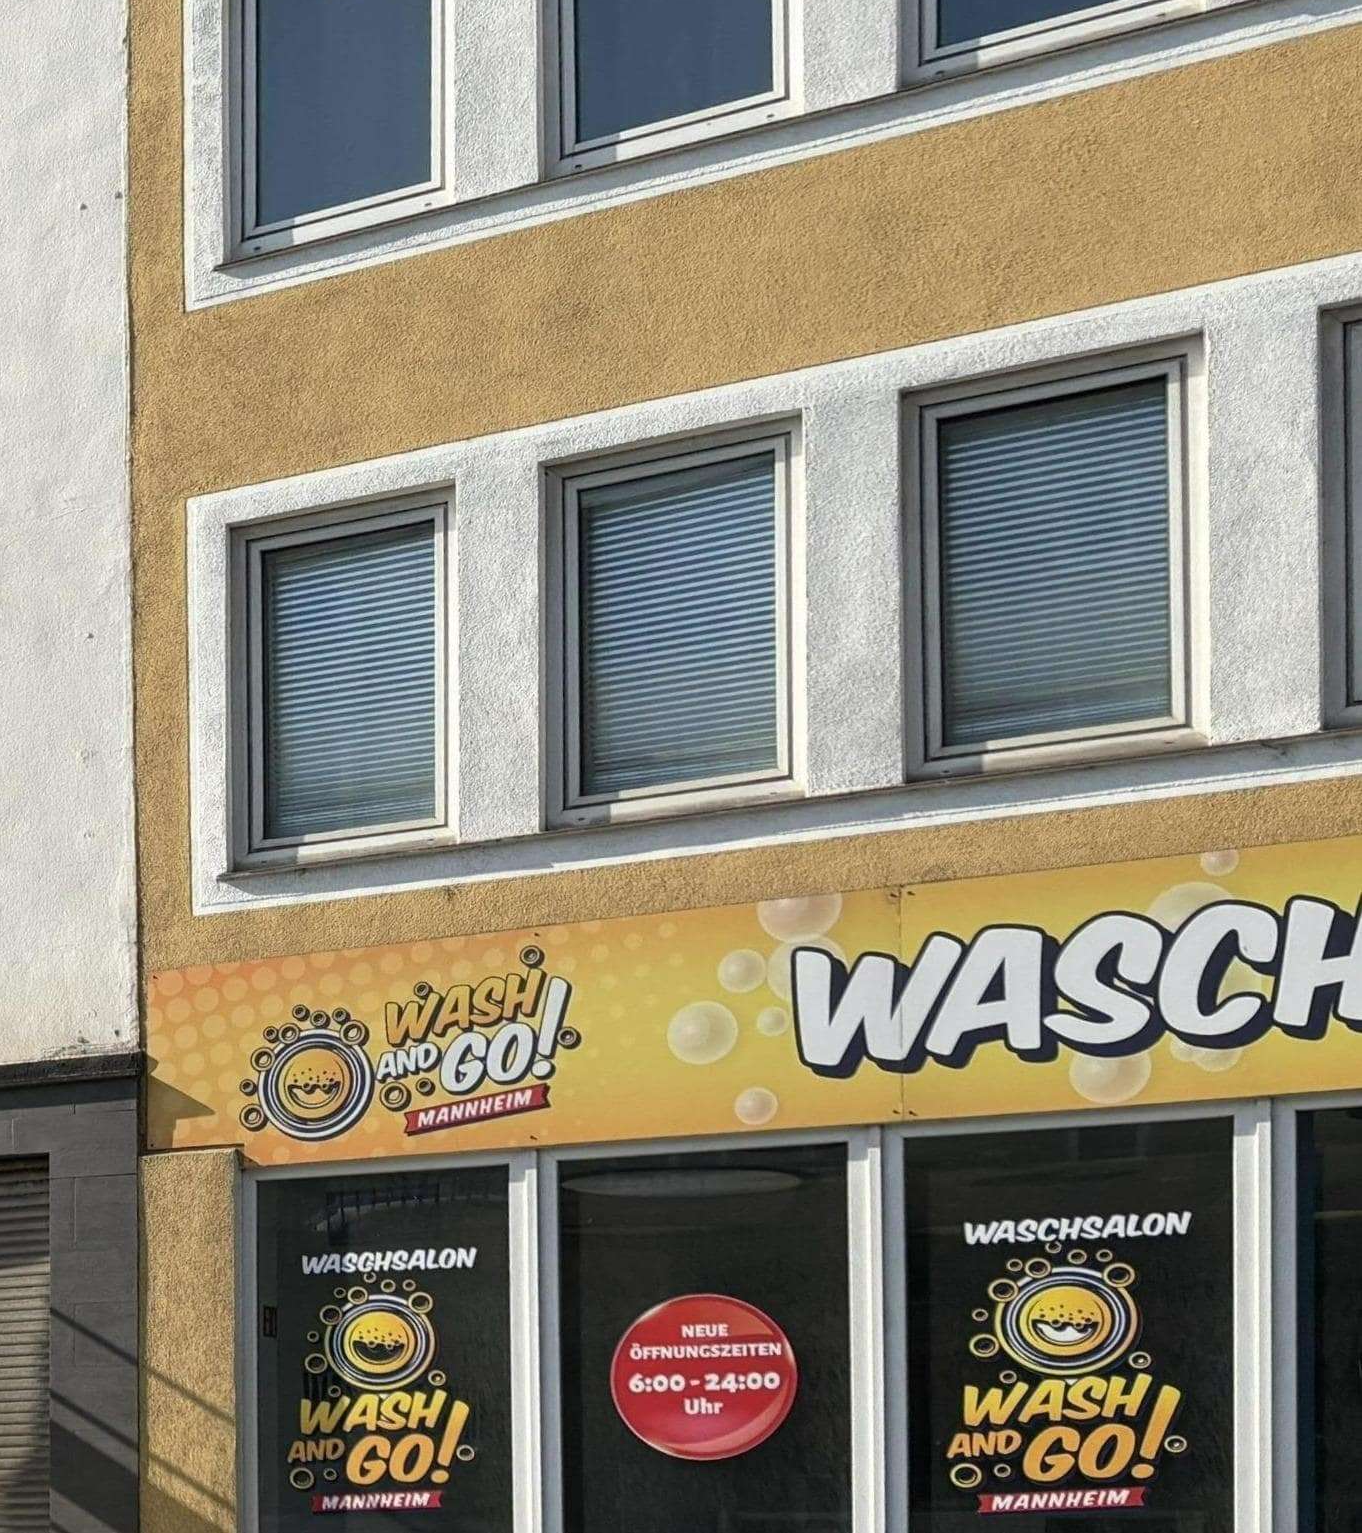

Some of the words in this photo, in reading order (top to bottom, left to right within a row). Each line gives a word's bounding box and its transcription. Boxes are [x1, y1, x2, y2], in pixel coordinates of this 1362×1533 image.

[384, 968, 547, 1047] WASH
[377, 1042, 441, 1081] AND
[440, 976, 572, 1095] GO!
[416, 1089, 533, 1128] MANNHEIM
[963, 1211, 1192, 1245] WASCHSALON
[301, 1247, 478, 1275] WASCHSALON
[681, 1323, 730, 1338] NEUE
[629, 1342, 782, 1360] ÖFFNUNGSZEITEN
[628, 1373, 686, 1393] 6:00
[703, 1371, 781, 1393] 24:00
[299, 1389, 447, 1435] WASH
[683, 1397, 724, 1415] Uhr
[963, 1373, 1153, 1426] WASH
[287, 1438, 346, 1464] AND
[345, 1399, 470, 1485] GO!
[946, 1429, 1023, 1458] AND
[1022, 1384, 1181, 1482] GO!
[321, 1492, 431, 1511] MANNHEIM
[991, 1489, 1131, 1511] MANNHEIM
